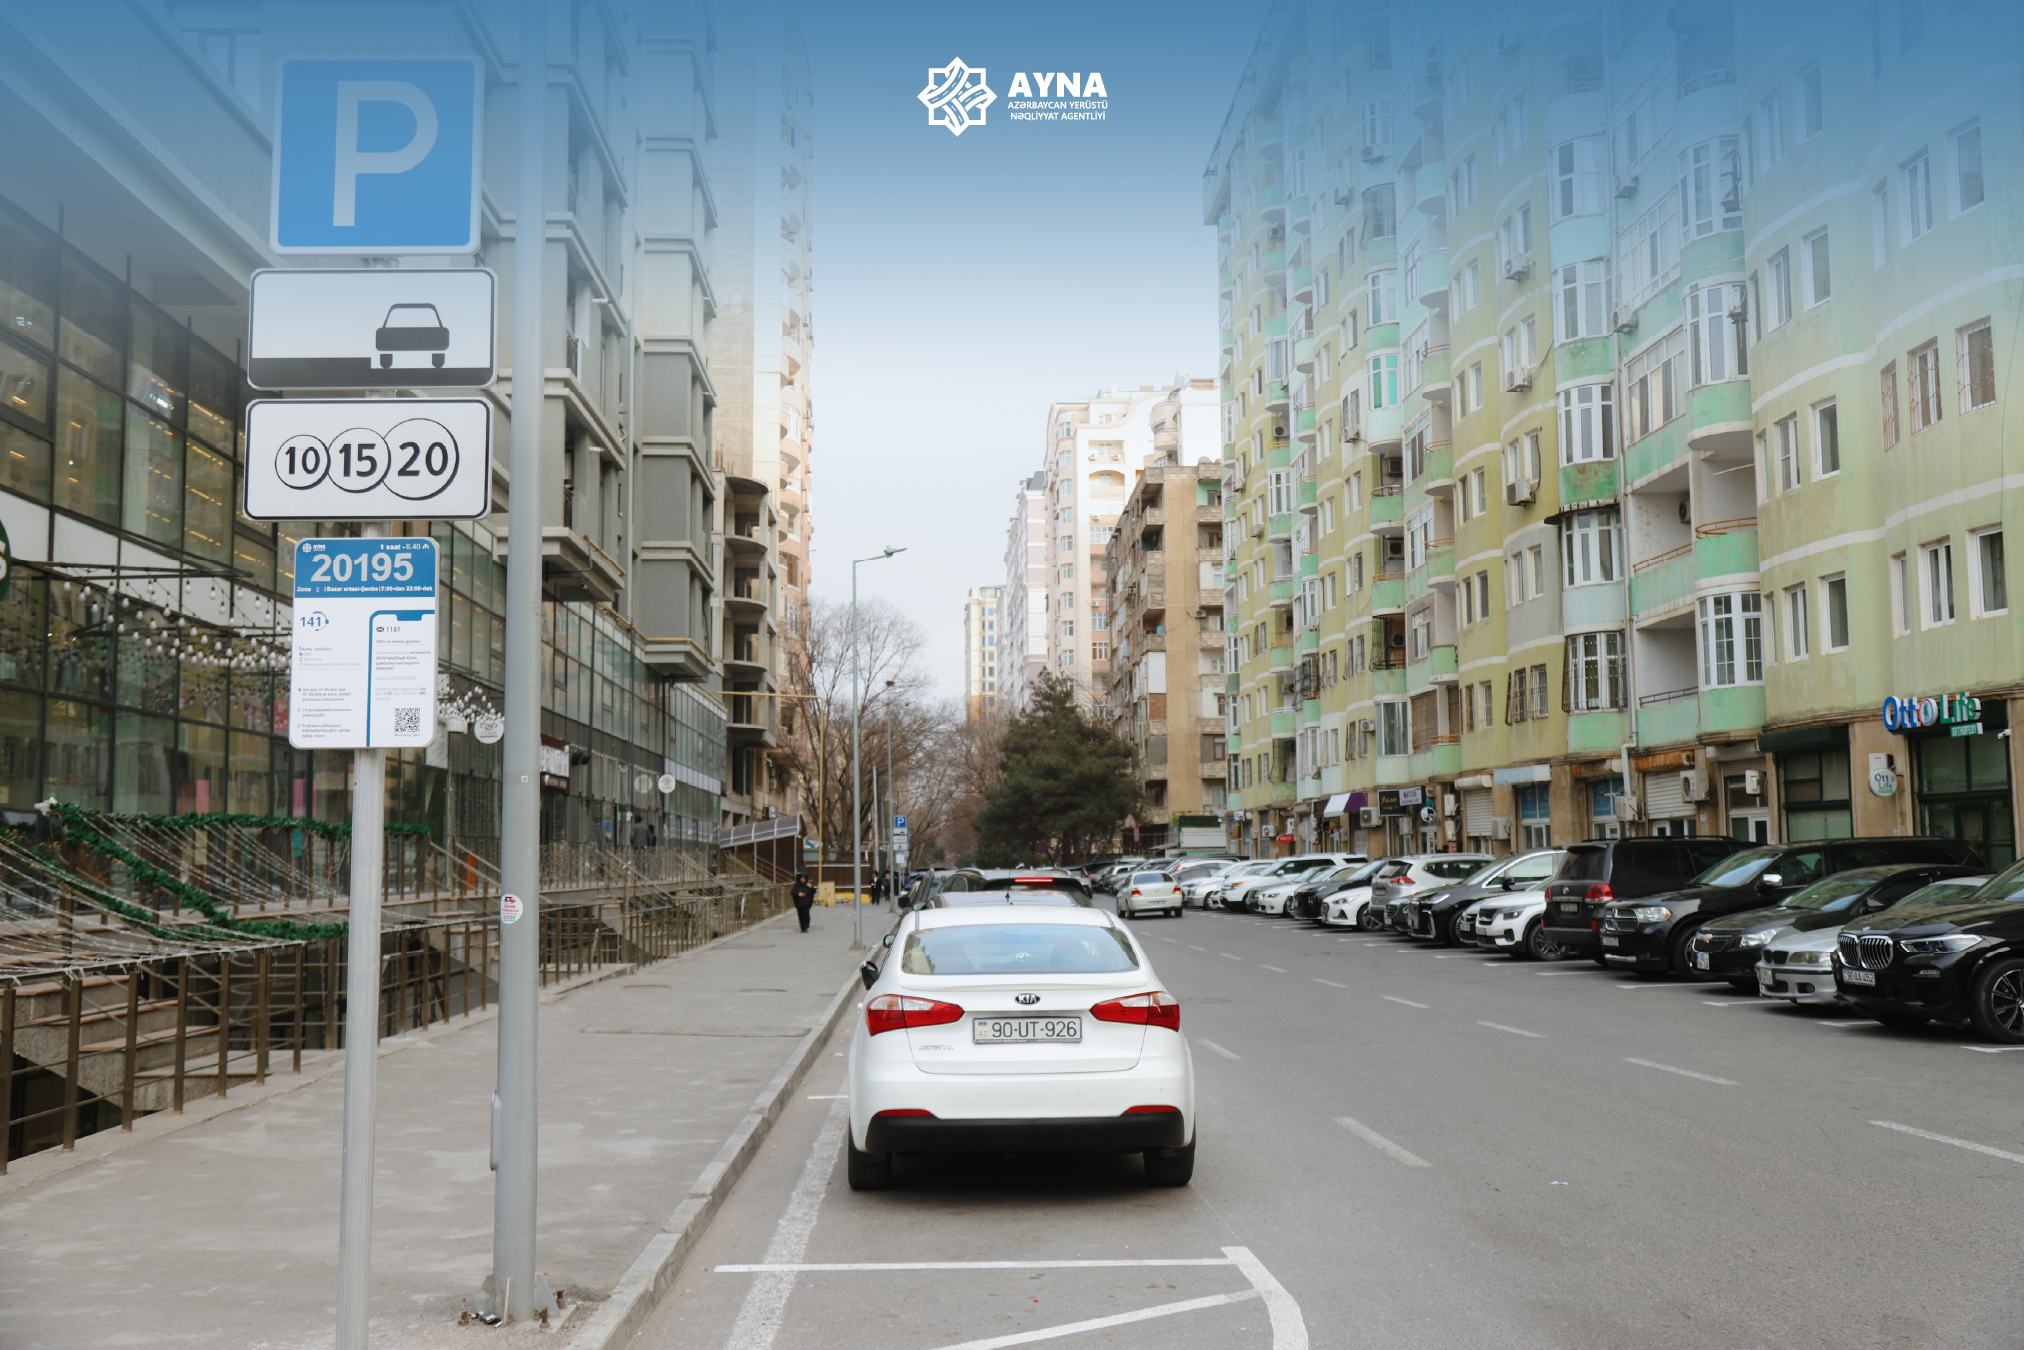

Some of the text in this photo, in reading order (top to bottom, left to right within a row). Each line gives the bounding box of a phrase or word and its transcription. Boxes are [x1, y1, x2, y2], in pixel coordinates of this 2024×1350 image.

[333, 80, 439, 227] P
[285, 441, 449, 478] 10 15 20
[310, 552, 414, 582] 20195
[300, 616, 321, 627] 141
[1883, 691, 1982, 731] Otto Life
[1874, 773, 1896, 782] Otto
[1878, 781, 1893, 790] Life
[897, 817, 905, 828] P
[1017, 994, 1037, 1004] KIA
[991, 1020, 1078, 1038] 90-UT-926
